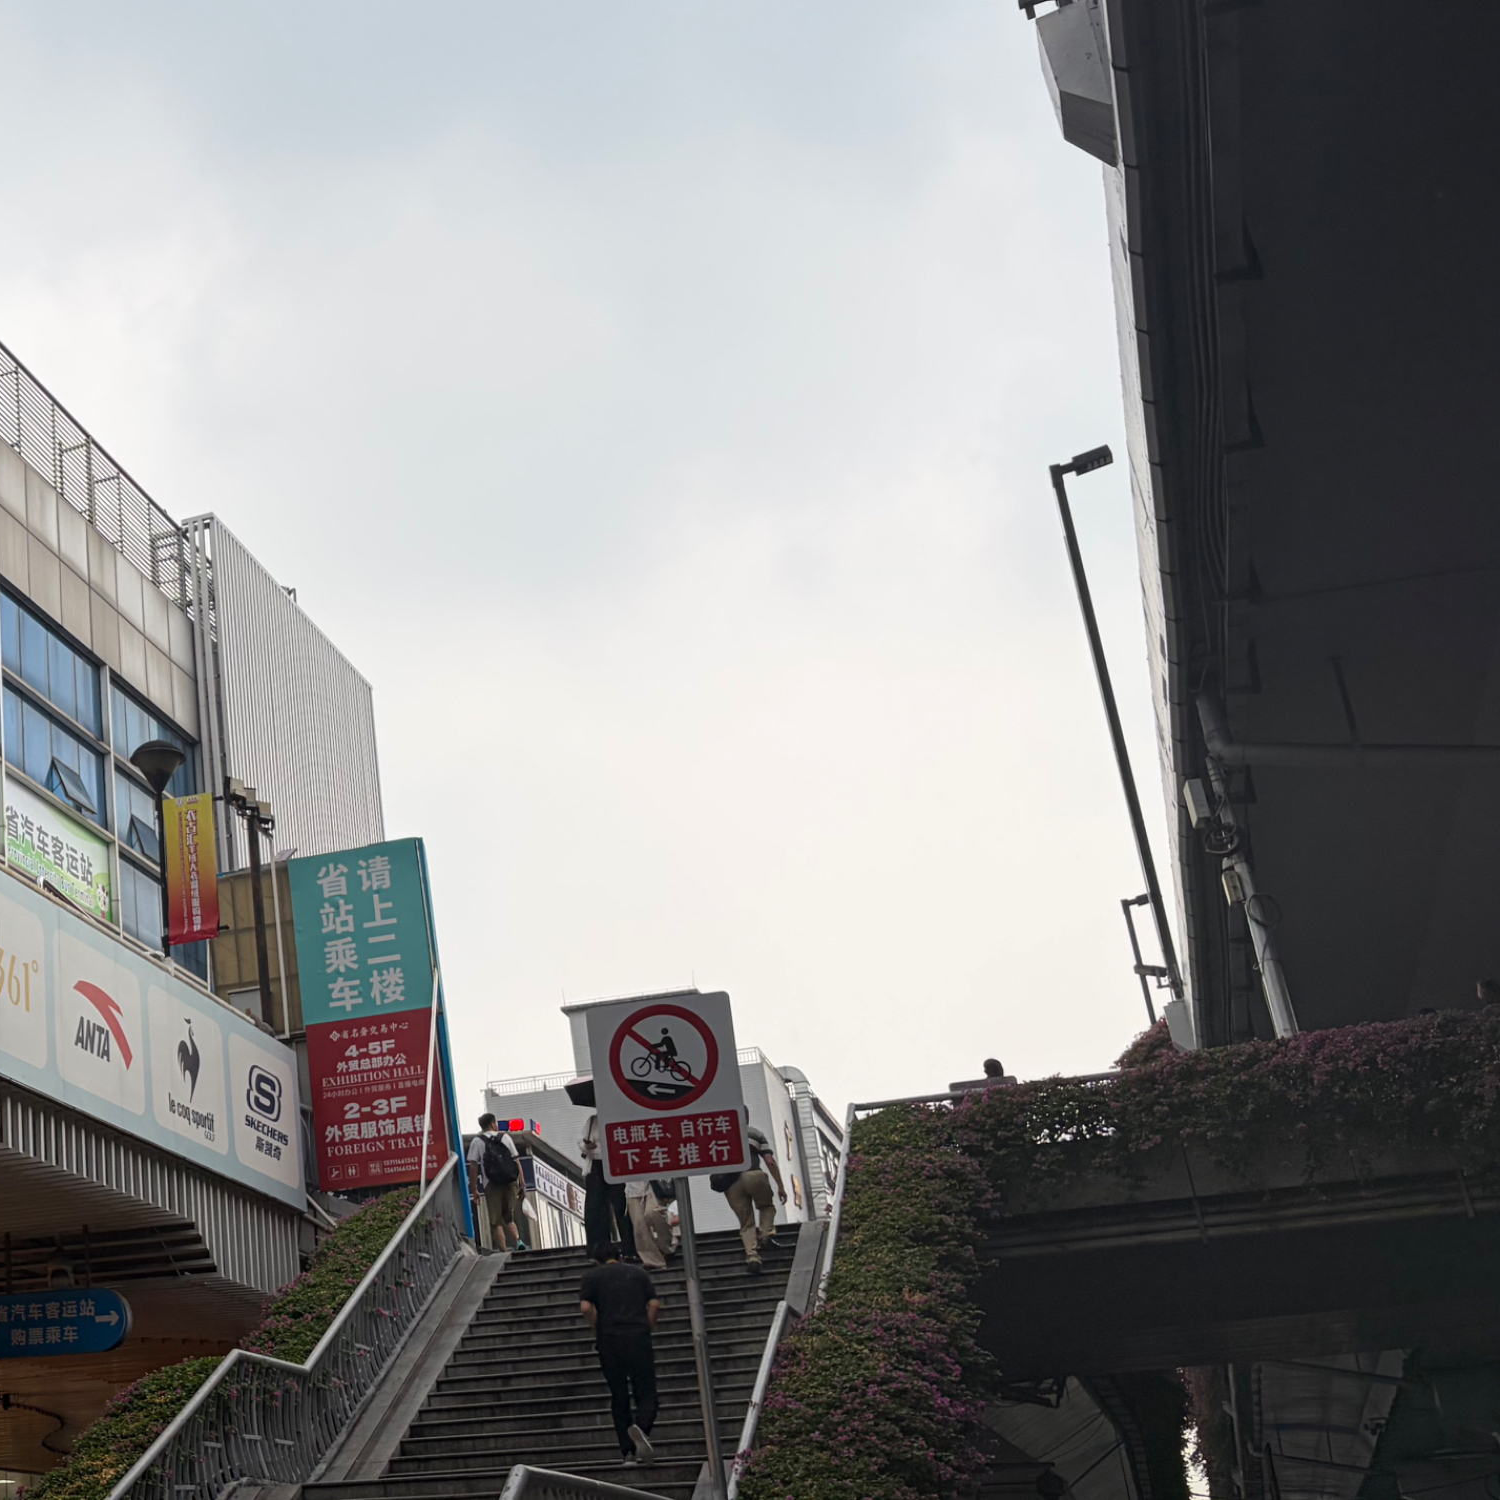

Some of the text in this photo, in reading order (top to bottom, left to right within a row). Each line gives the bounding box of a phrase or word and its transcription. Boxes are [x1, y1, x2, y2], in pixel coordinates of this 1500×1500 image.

[6, 805, 93, 888] 省汽车客运站
[316, 862, 363, 1012] 省站乘车
[357, 855, 406, 1006] 请上二楼
[74, 1015, 111, 1063] ANTA
[344, 1039, 395, 1057] 4-5F
[322, 1065, 424, 1087] EXHIBITION HALL
[336, 1052, 407, 1073] 外贸总部办公
[168, 1092, 176, 1113] le
[177, 1102, 191, 1126] coq
[343, 1096, 408, 1119] 2-3F
[204, 1130, 216, 1143] GOLF
[245, 1114, 289, 1146] SKECHERS
[613, 1115, 732, 1145] 电瓶车、自行车
[255, 1135, 282, 1161] 斯凯奇
[327, 1140, 385, 1157] FOREIGN
[619, 1140, 731, 1170] 下车推行
[10, 1324, 79, 1346] 购票乘车
